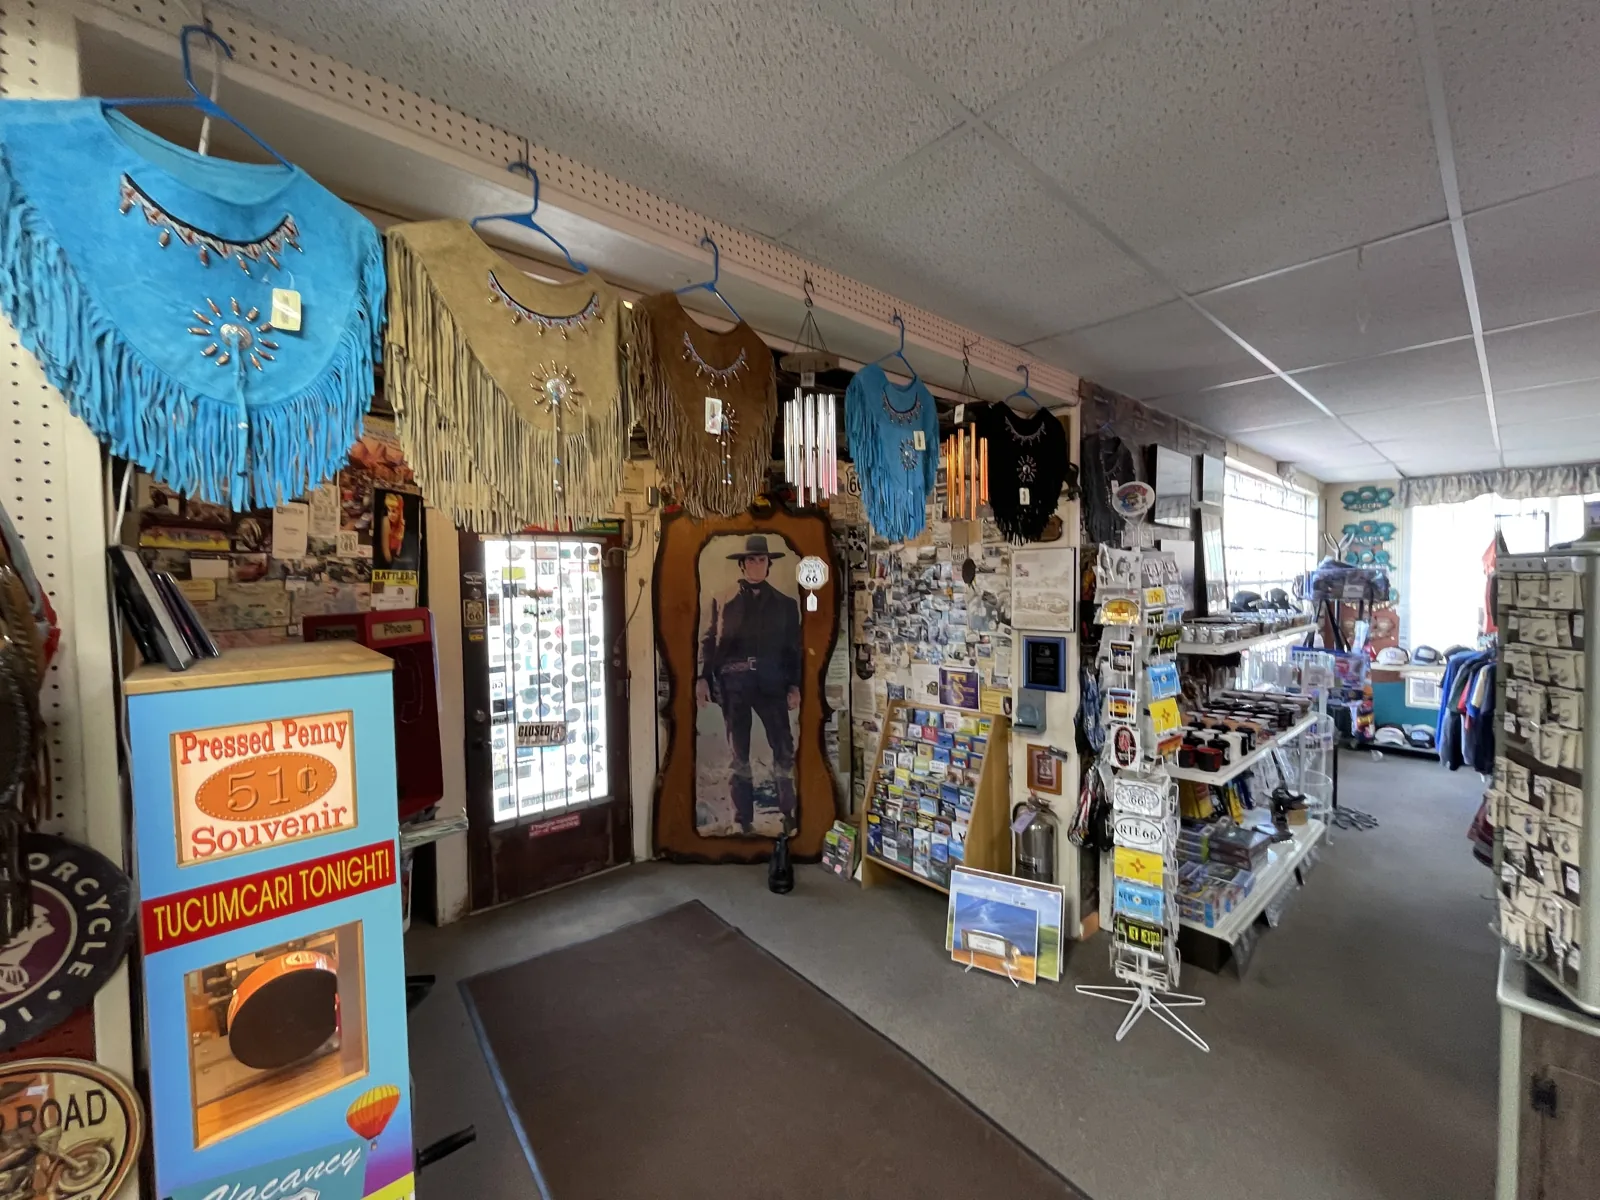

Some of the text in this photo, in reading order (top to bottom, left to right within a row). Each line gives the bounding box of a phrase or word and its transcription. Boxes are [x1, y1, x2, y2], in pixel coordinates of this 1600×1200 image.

[374, 570, 416, 582] RATTLERS
[805, 574, 818, 583] 66
[383, 623, 412, 636] Phone
[468, 611, 482, 621] 66
[316, 628, 357, 640] Phone
[179, 718, 348, 765] Pressed Penny
[518, 725, 551, 737] CLOSED
[191, 801, 348, 858] Souvenir
[153, 848, 390, 941] TUCUMCARI TONIGHT!
[28, 852, 112, 978] ORCYCLE
[16, 1089, 107, 1133] ROAD
[200, 1146, 361, 1200] Vacancy
